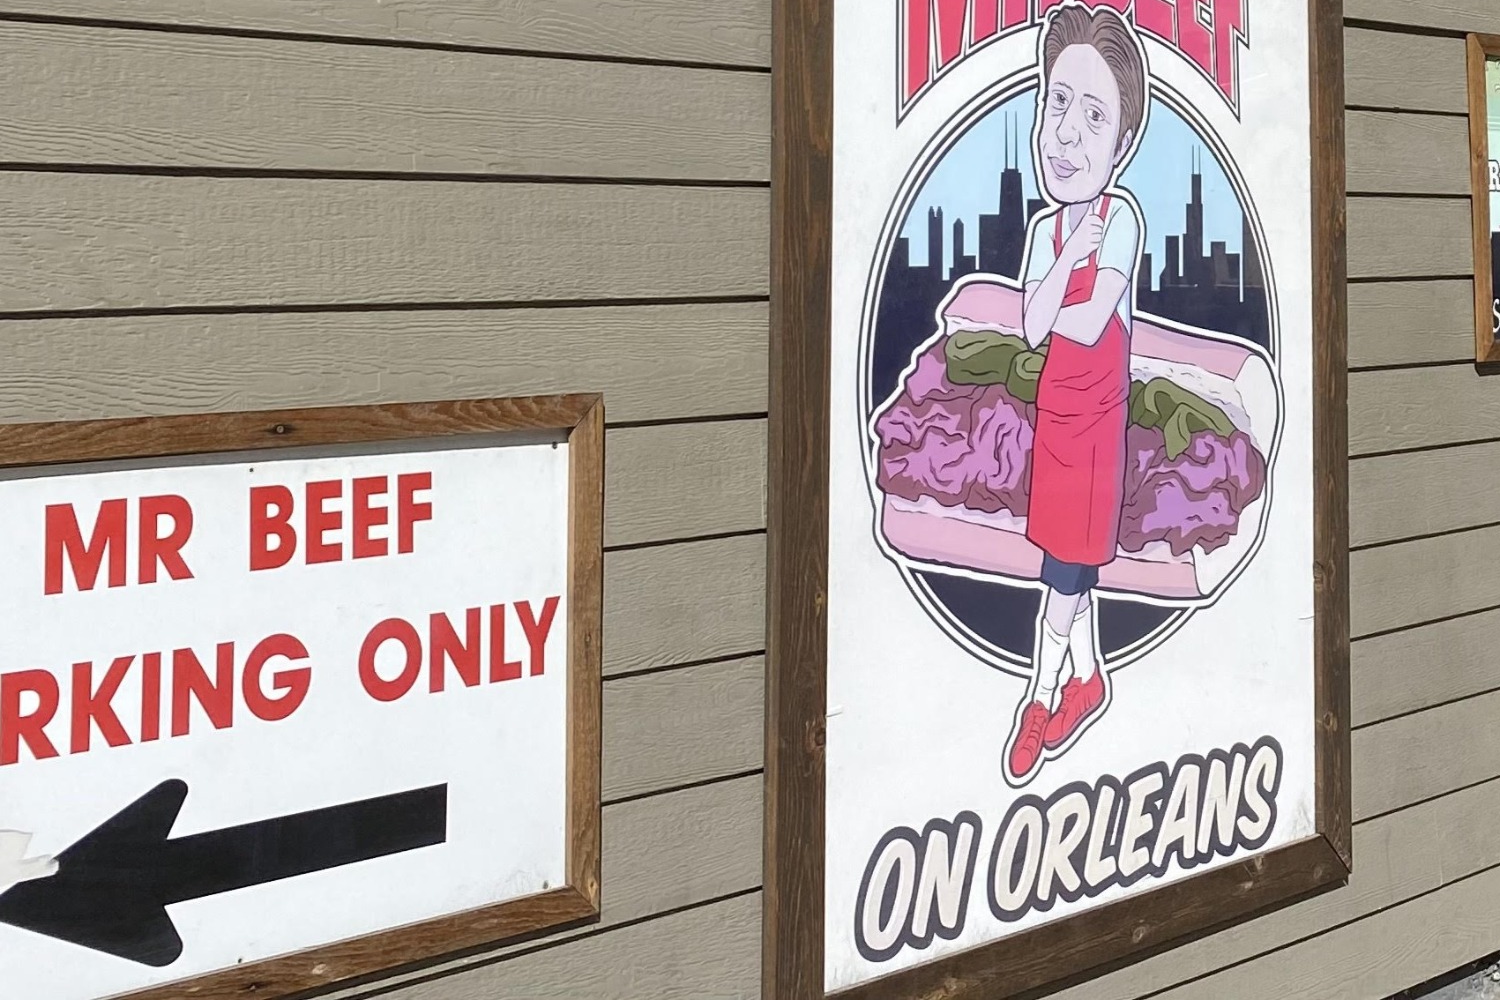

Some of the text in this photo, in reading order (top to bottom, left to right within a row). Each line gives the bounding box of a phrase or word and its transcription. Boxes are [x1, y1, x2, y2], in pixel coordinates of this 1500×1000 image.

[44, 471, 433, 596] MR BEEF
[0, 595, 562, 767] RKING ONLY
[854, 735, 1284, 962] ON ORLEANS
